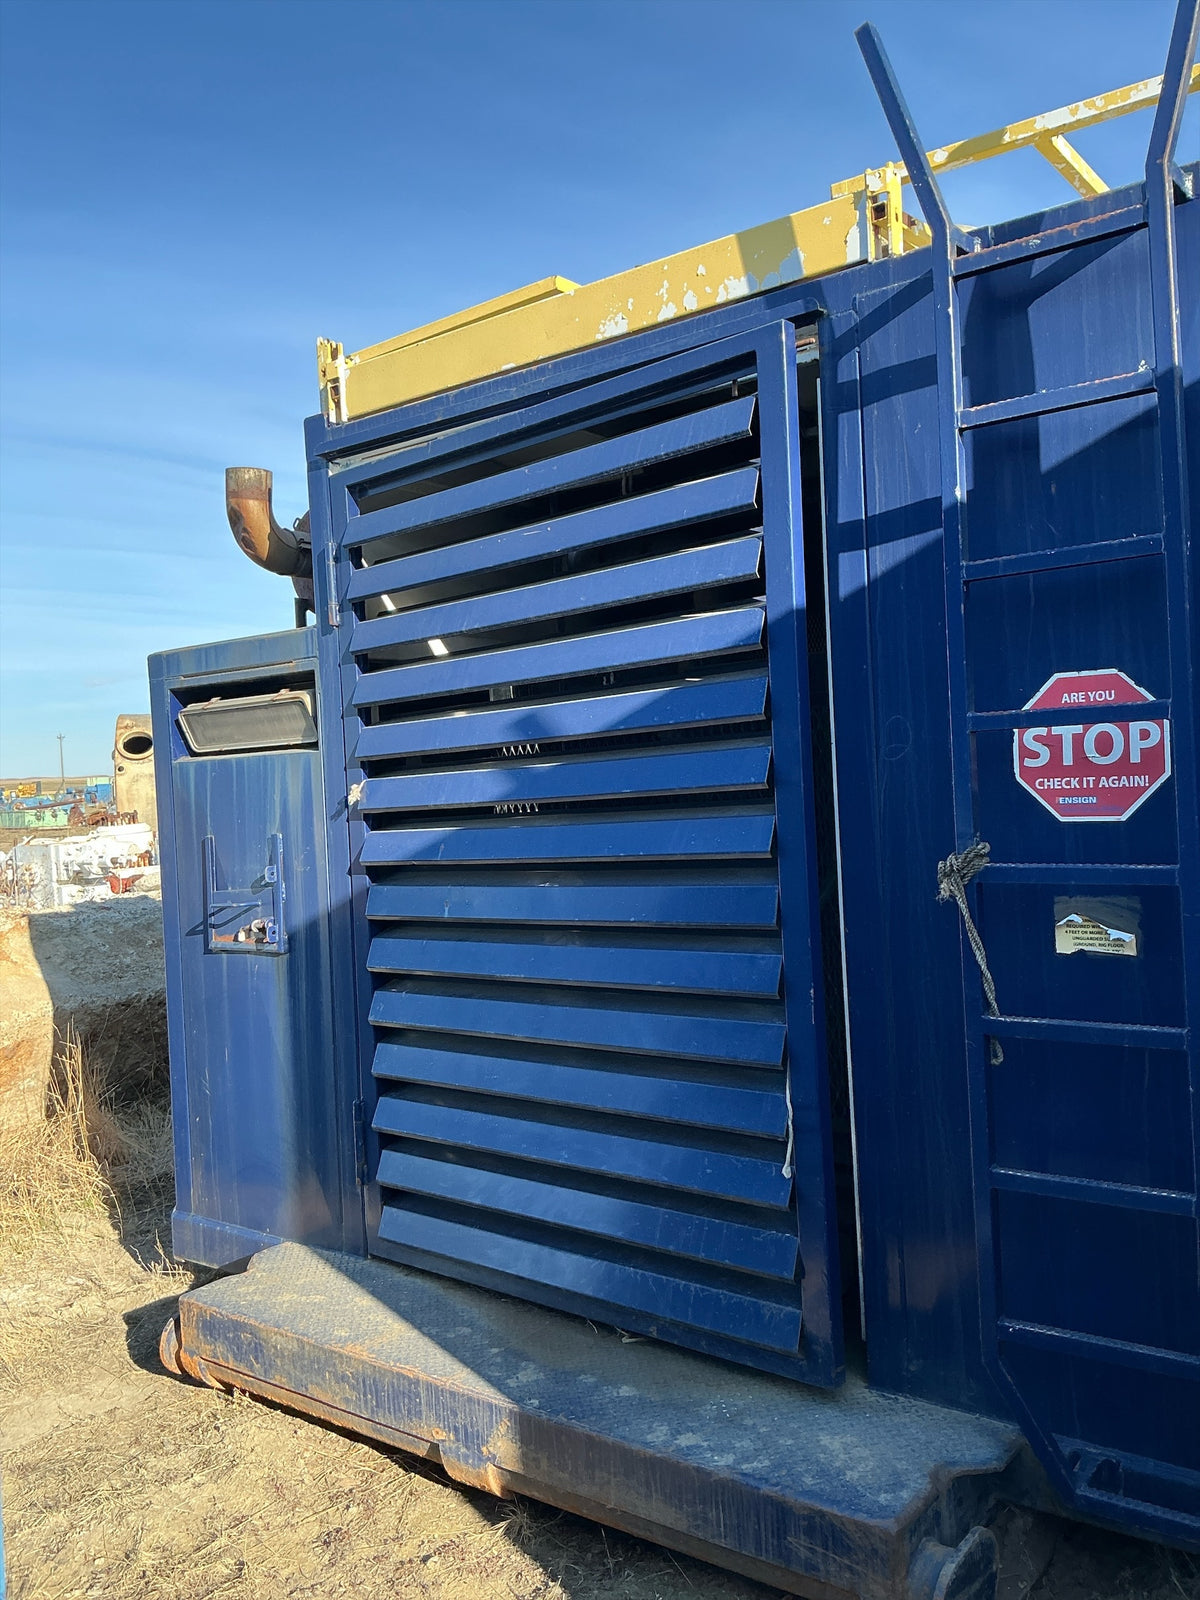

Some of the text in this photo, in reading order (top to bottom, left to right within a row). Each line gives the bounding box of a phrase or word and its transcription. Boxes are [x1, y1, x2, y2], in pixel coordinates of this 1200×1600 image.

[1061, 690, 1115, 704] ARE YOU
[1022, 721, 1161, 767] STOP
[1035, 775, 1149, 789] CHECK IT AGAIN!
[1059, 796, 1097, 804] ENSIGN
